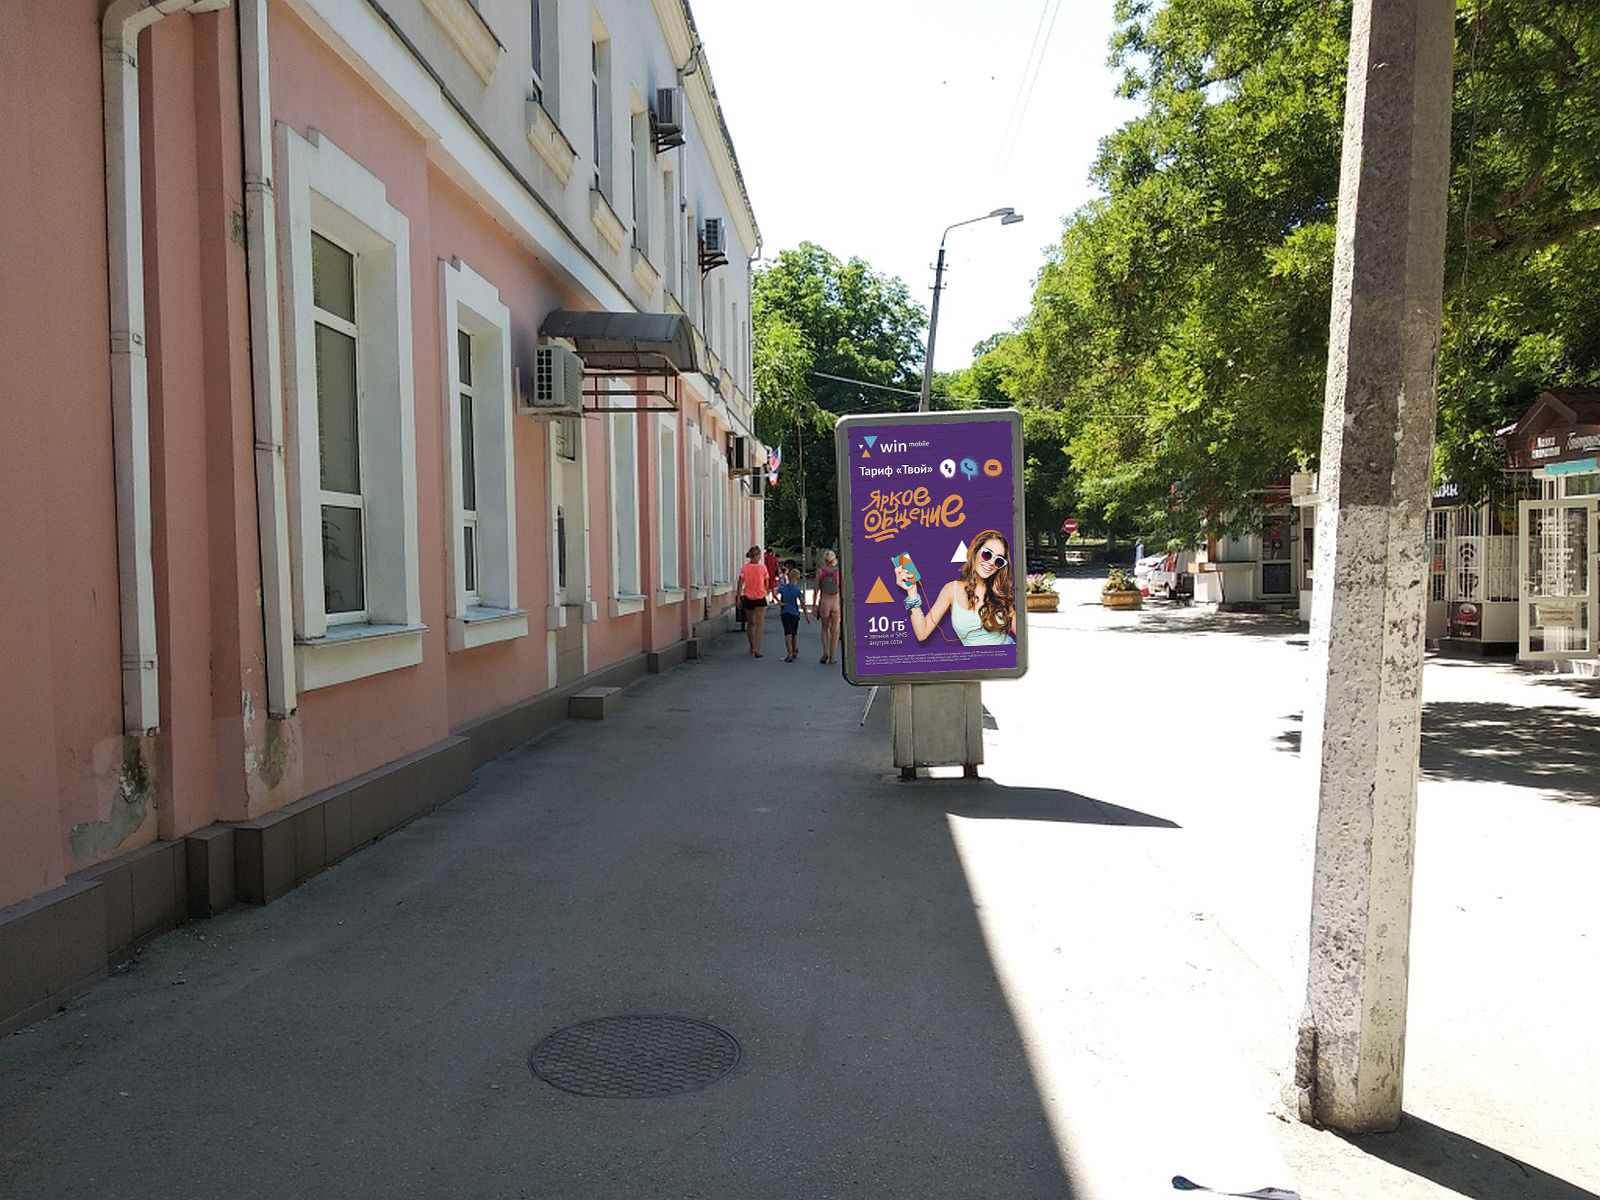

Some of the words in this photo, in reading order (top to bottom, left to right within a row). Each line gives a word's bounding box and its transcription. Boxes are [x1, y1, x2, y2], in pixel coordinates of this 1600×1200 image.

[880, 440, 907, 453] win
[859, 466, 893, 478] Тариф
[896, 464, 933, 475] «Твой»
[868, 616, 889, 633] 10
[895, 631, 908, 639] SMS
